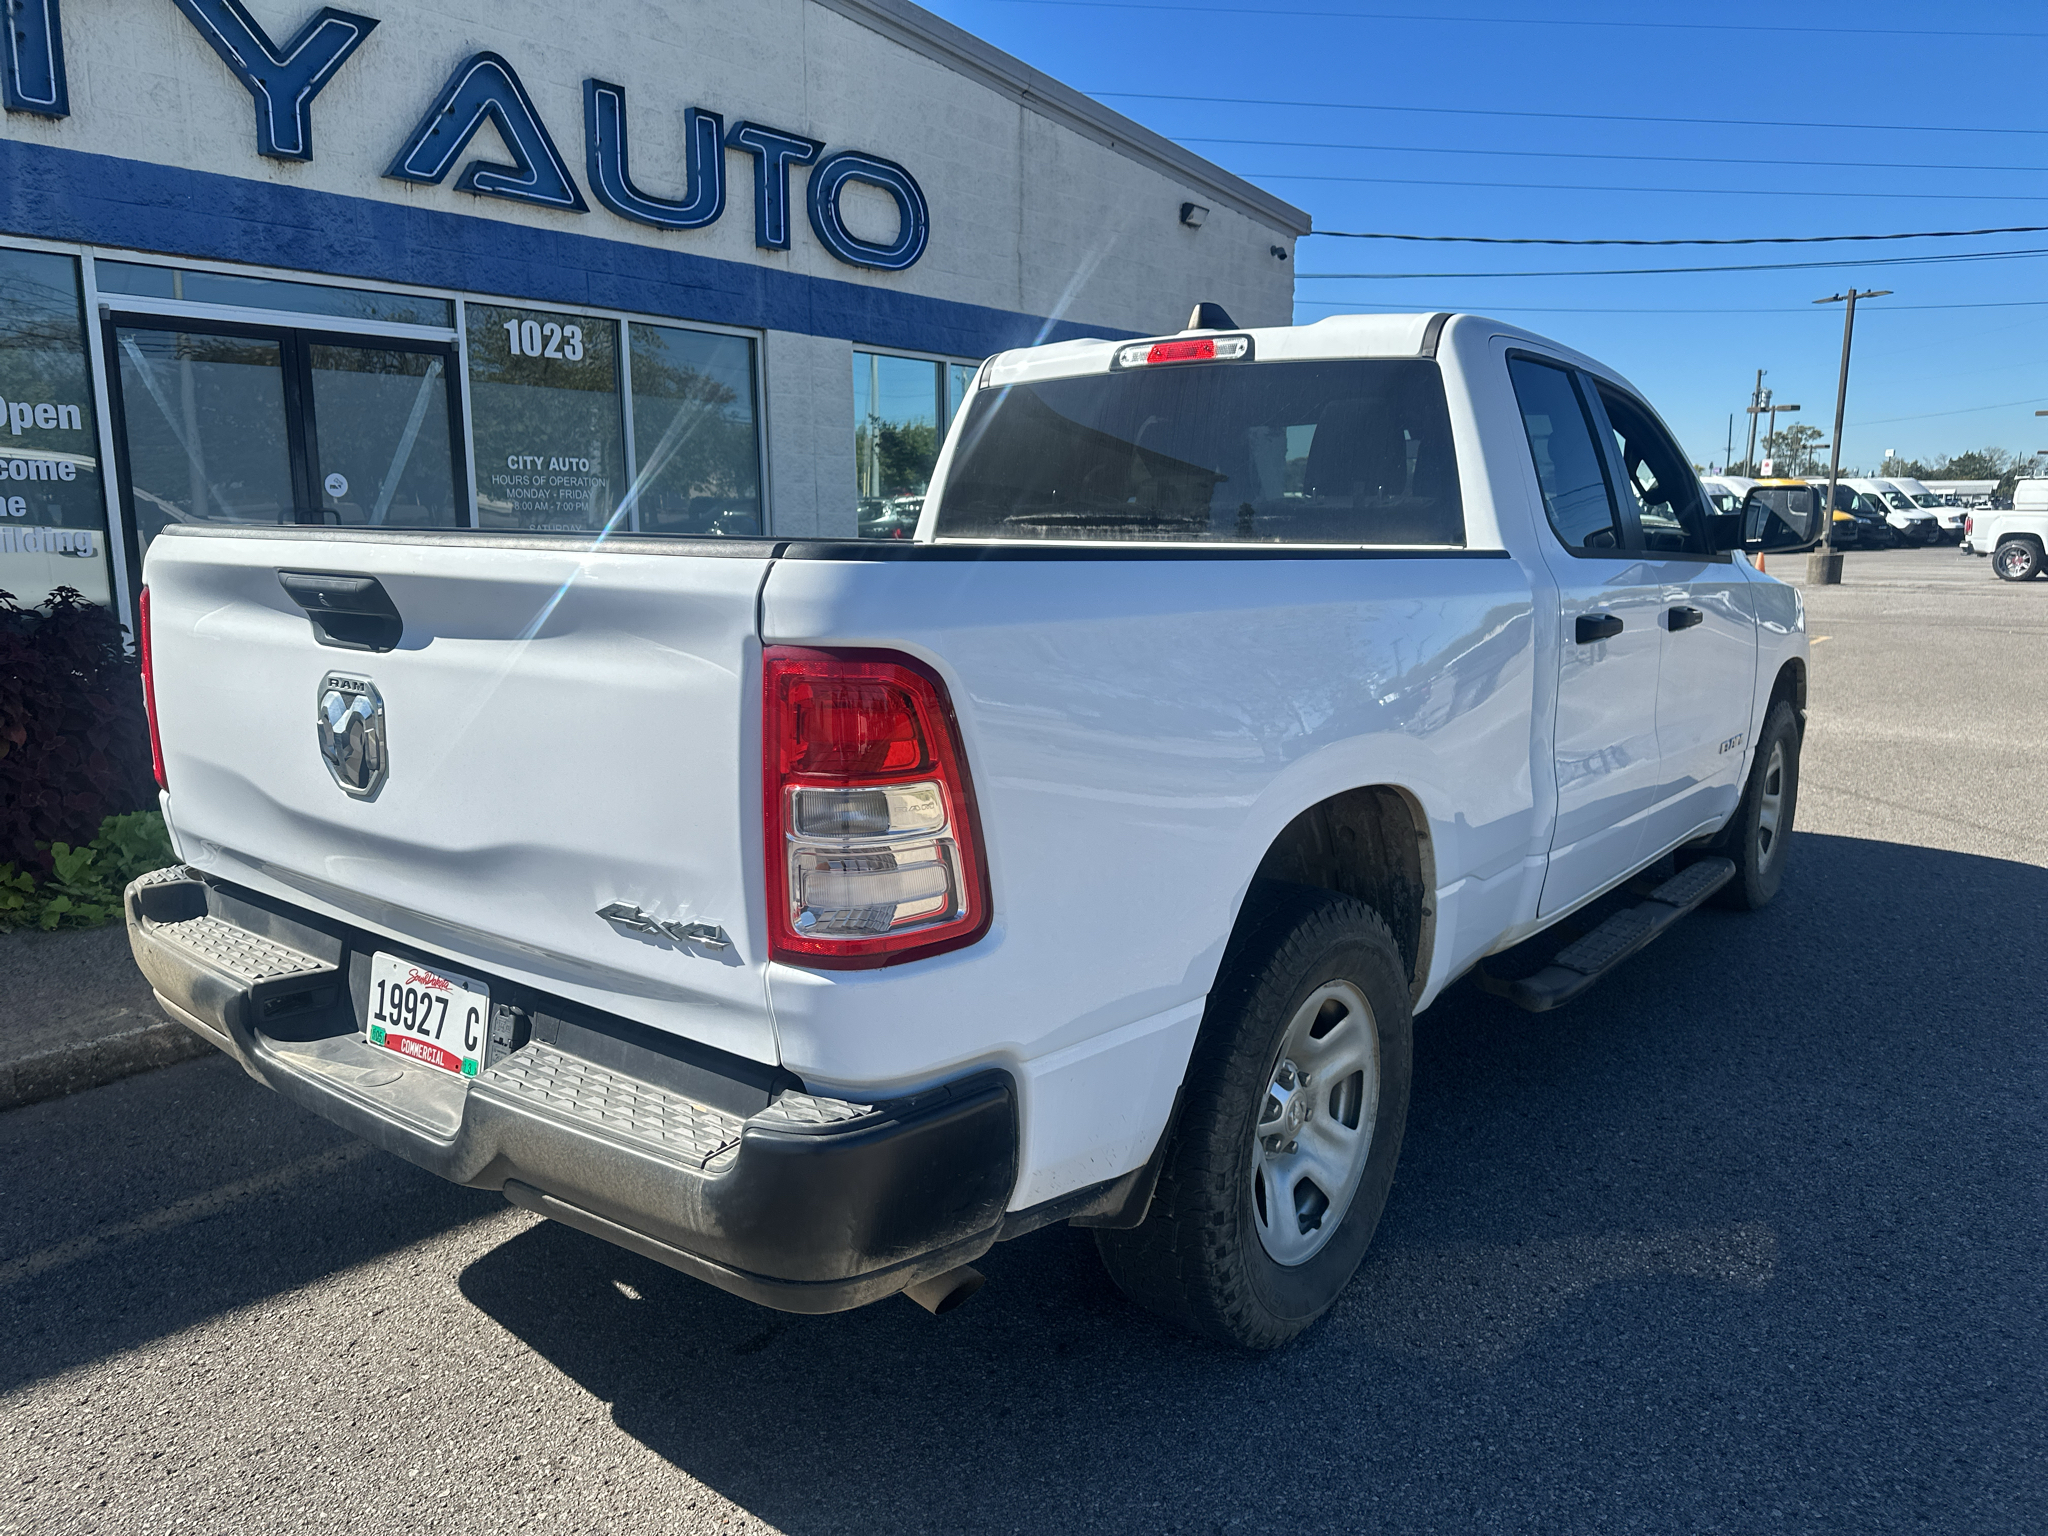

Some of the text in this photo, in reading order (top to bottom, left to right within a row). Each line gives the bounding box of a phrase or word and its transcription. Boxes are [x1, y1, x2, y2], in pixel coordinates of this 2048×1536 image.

[503, 318, 584, 361] 1023
[0, 396, 82, 435] pen
[507, 455, 590, 472] CITY AUTO
[491, 474, 606, 488] HOURS OF OPERATION
[506, 488, 551, 499] MONDAY
[559, 489, 594, 500] FRIDAY
[514, 501, 533, 511] 8:00
[534, 502, 549, 511] AM
[556, 502, 574, 511] 7:00
[575, 502, 589, 512] PM
[328, 678, 365, 692] RAM
[374, 979, 480, 1052] 19927 C
[400, 1038, 445, 1066] COMMERCIAL
